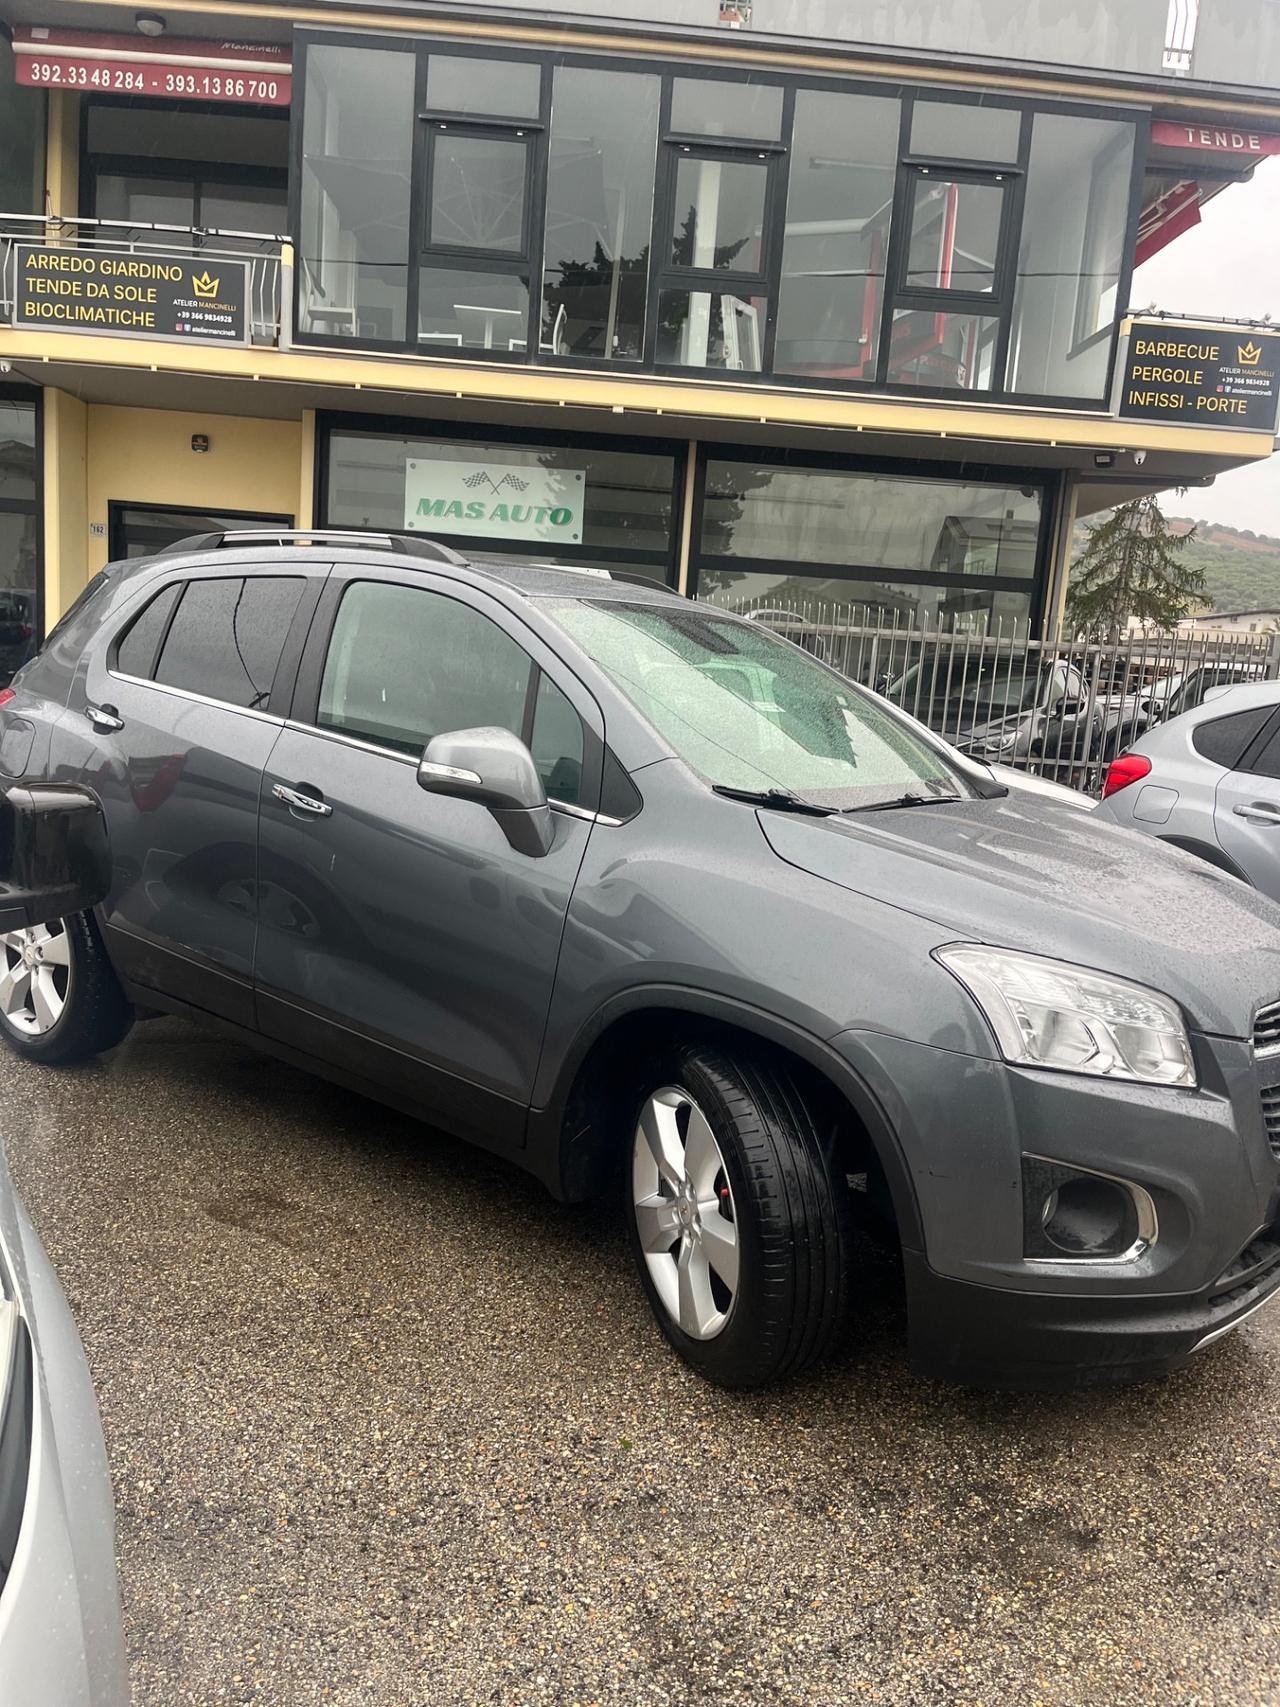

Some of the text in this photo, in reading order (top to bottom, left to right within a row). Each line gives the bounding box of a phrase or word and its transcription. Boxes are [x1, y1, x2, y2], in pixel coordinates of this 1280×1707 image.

[1184, 128, 1261, 150] TENDE
[25, 254, 183, 281] ARREDO GIARDINO
[25, 278, 157, 303] TENDE DA SOLE
[25, 302, 155, 327] BIOCLIMATICHE
[173, 299, 237, 311] ATELIER MANCINELLI
[177, 311, 190, 319] +39
[191, 312, 203, 320] 366
[1135, 340, 1220, 361] BARBECUE
[1132, 366, 1204, 385] PERGOLE
[1128, 391, 1184, 408] INFISSI
[1196, 396, 1248, 414] PORTE
[416, 498, 574, 526] MAS AUTO
[93, 525, 104, 534] 162
